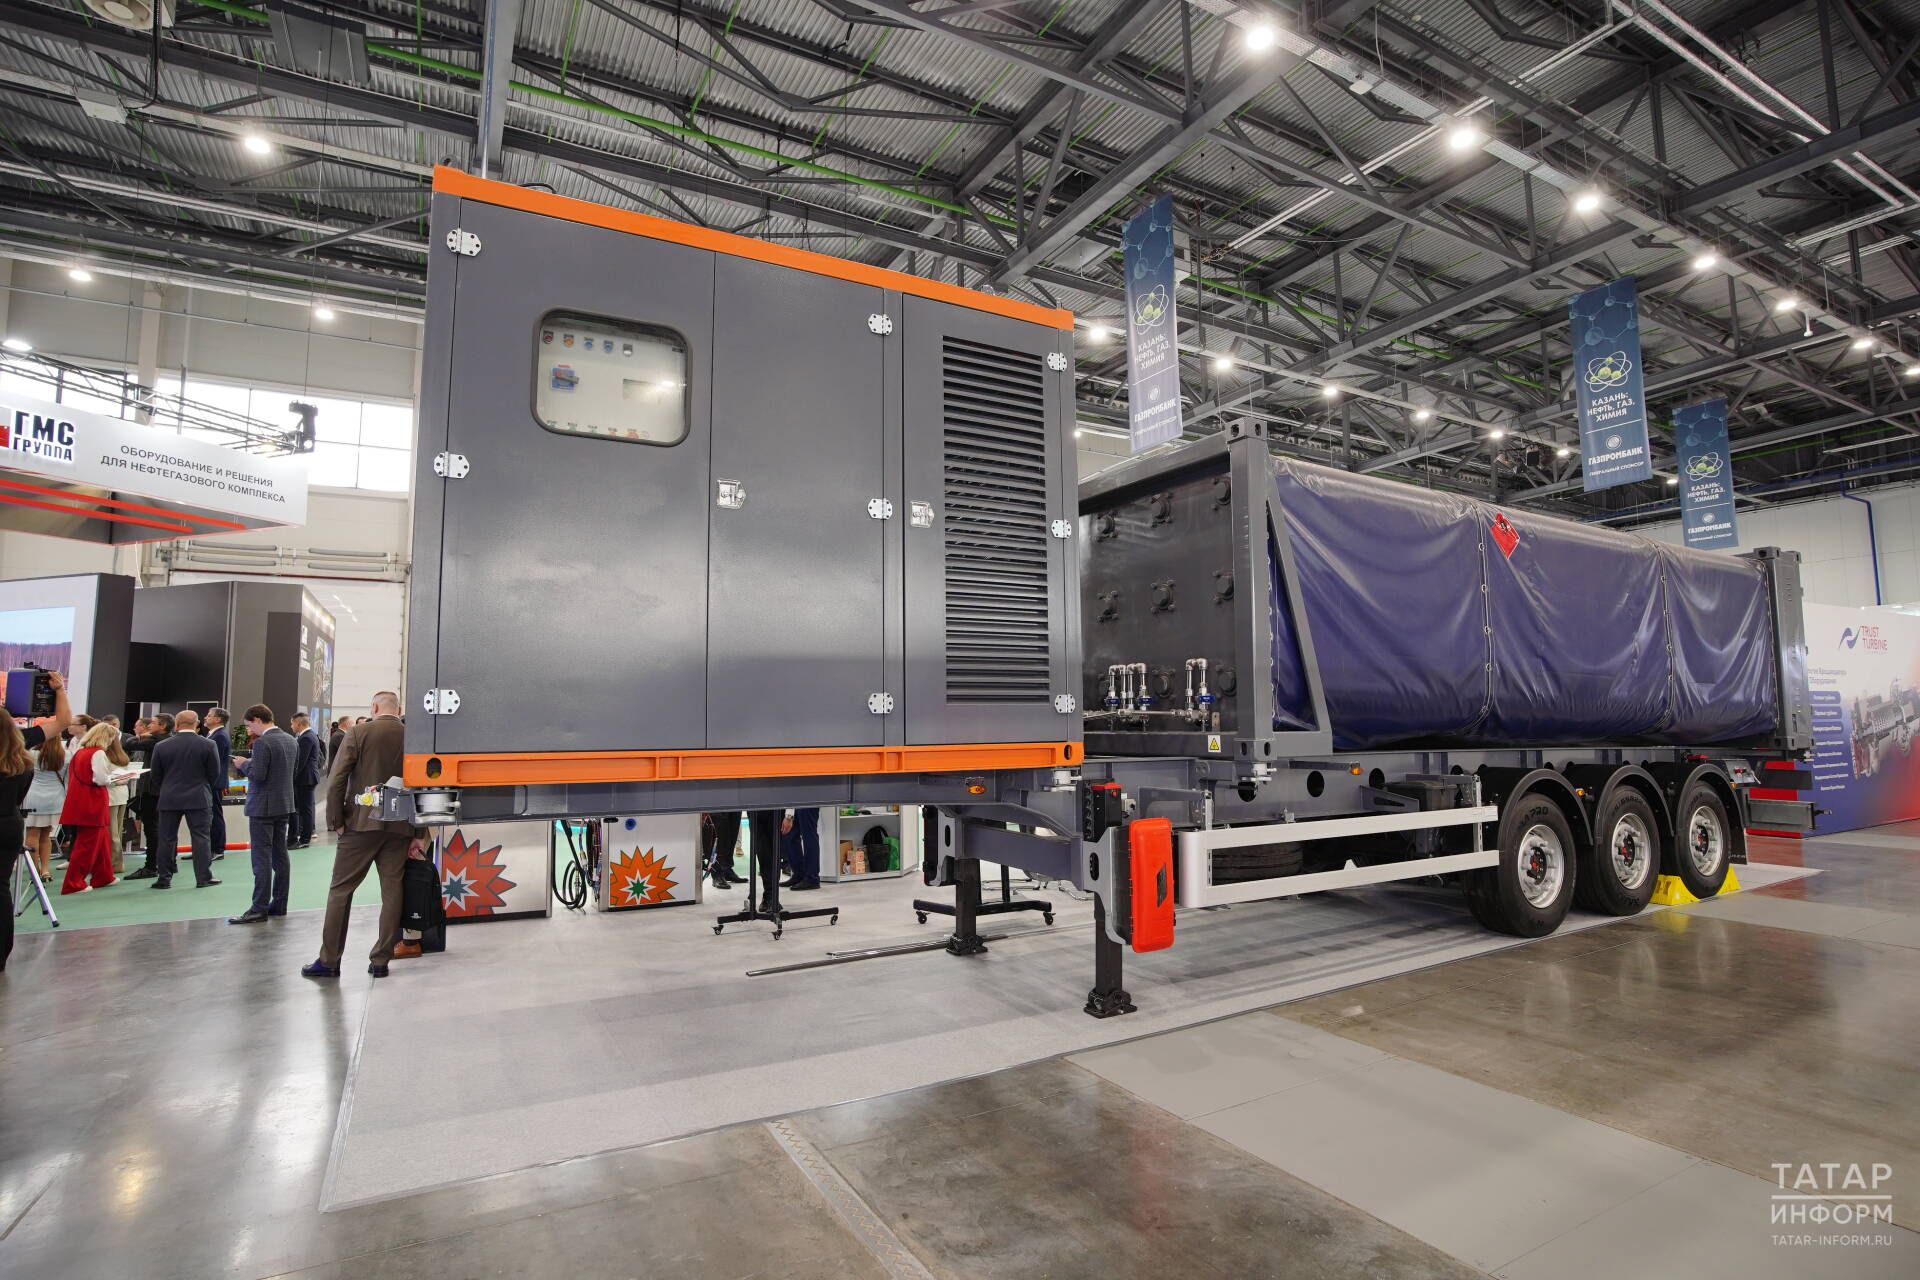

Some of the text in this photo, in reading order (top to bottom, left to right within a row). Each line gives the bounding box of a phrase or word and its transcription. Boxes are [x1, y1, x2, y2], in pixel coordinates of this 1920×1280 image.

[1591, 392, 1629, 407] КАЗАНЬ:
[1596, 408, 1627, 422] ХИМИЯ
[15, 410, 75, 446] ГМС
[13, 437, 72, 461] ГРУППА
[1588, 446, 1643, 465] ГАЗПРОМБАНК
[120, 445, 273, 488] ОБОРУДОВАНИЕ И РЕШЕНИЯ
[100, 455, 286, 503] ДЛЯ НЕФТЕГАЗОВОГО КОМПЛЕКСА
[1688, 522, 1732, 535] ГАЗПРОМБАНК
[1861, 625, 1880, 639] TRUST
[1862, 638, 1888, 651] TURBINE
